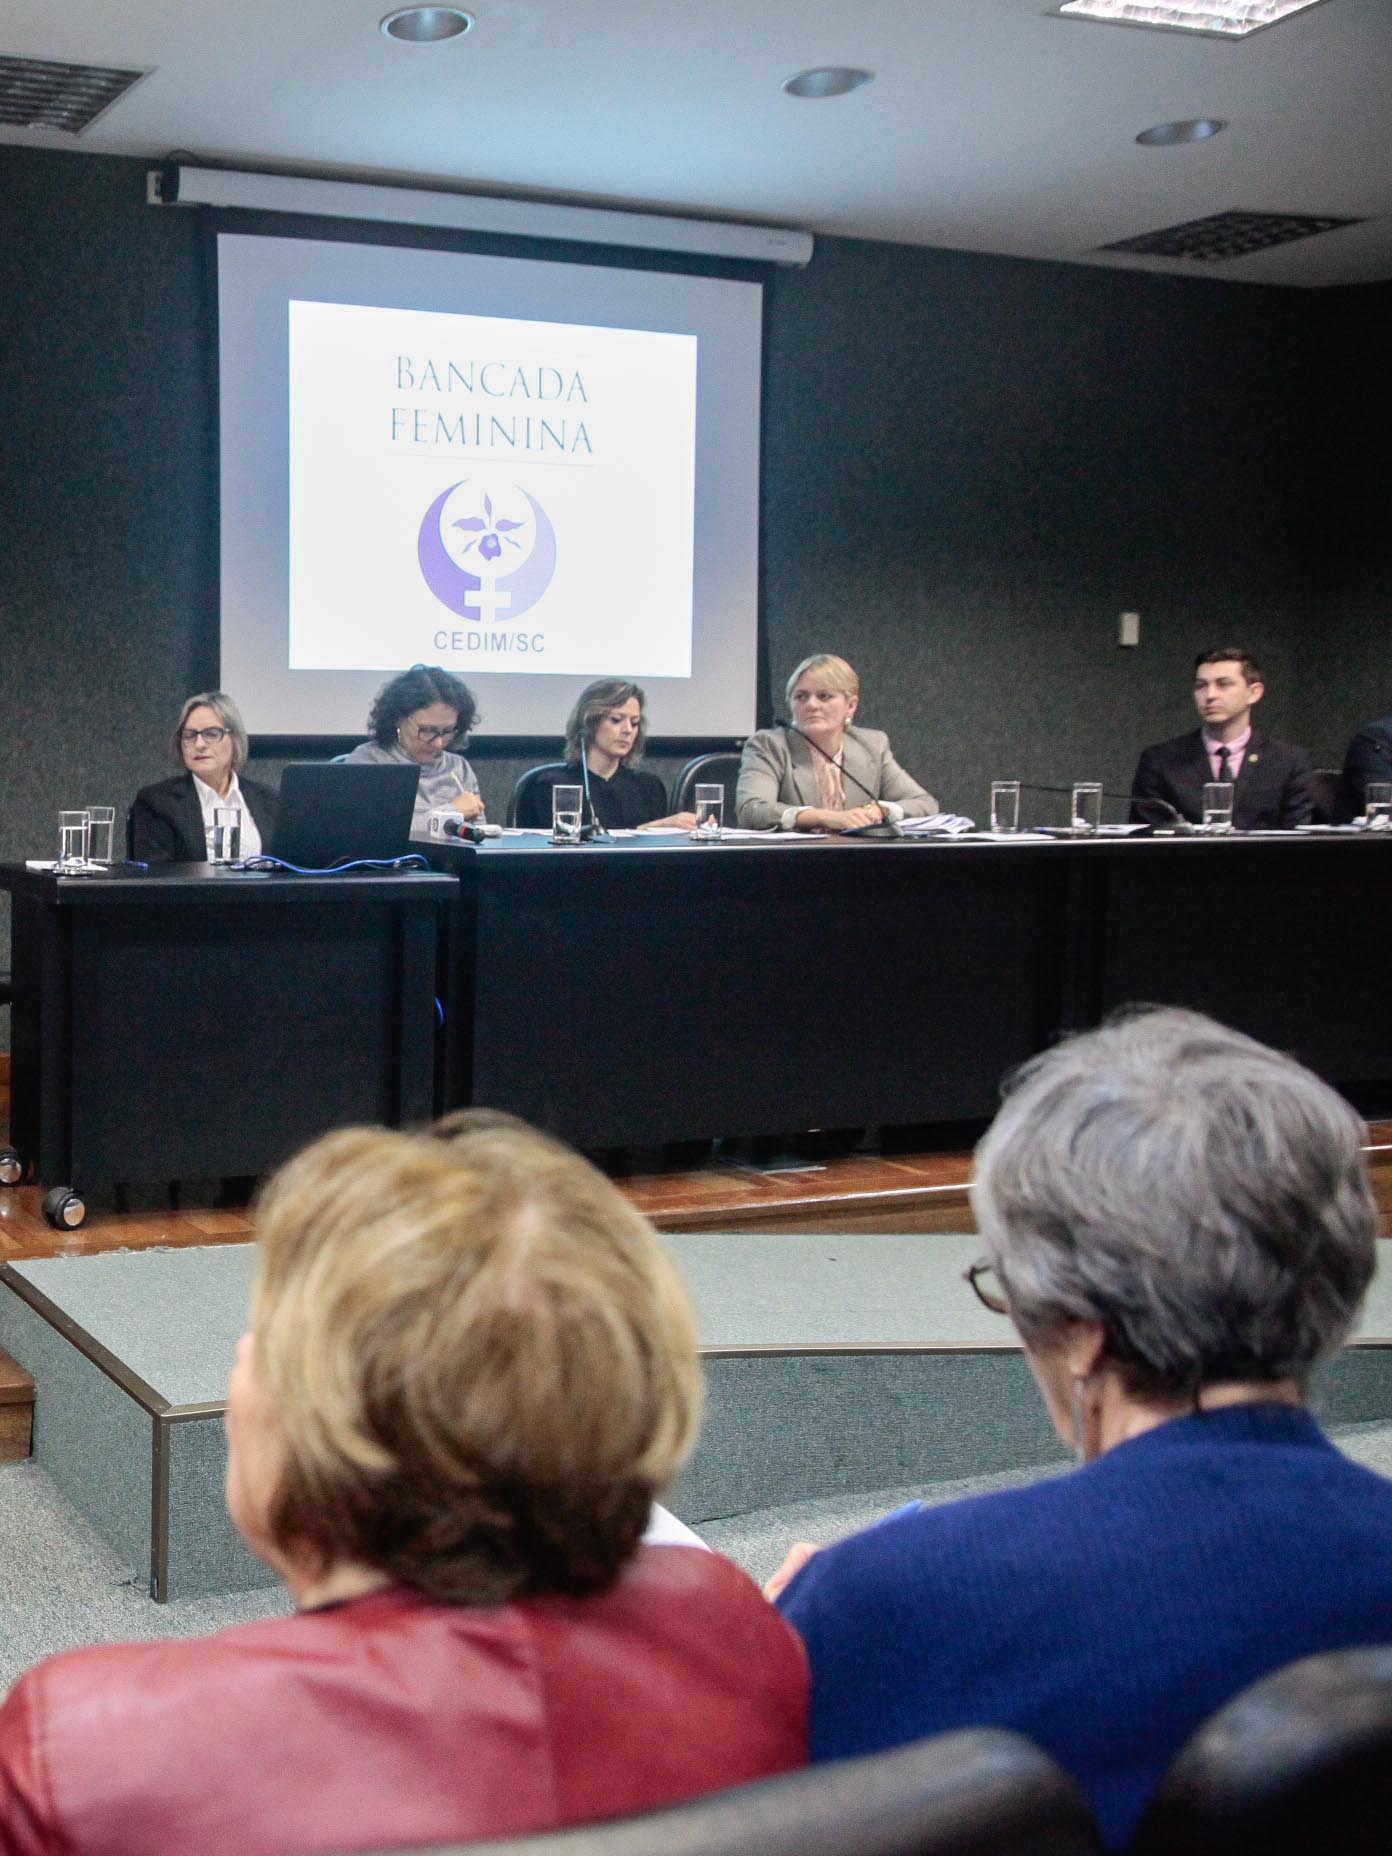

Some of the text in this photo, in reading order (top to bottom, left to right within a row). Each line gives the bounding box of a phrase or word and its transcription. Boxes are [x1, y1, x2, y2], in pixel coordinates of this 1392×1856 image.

[397, 355, 588, 403] BANCADA
[392, 407, 593, 454] FEMININA
[433, 630, 545, 653] CEDIM/SC
